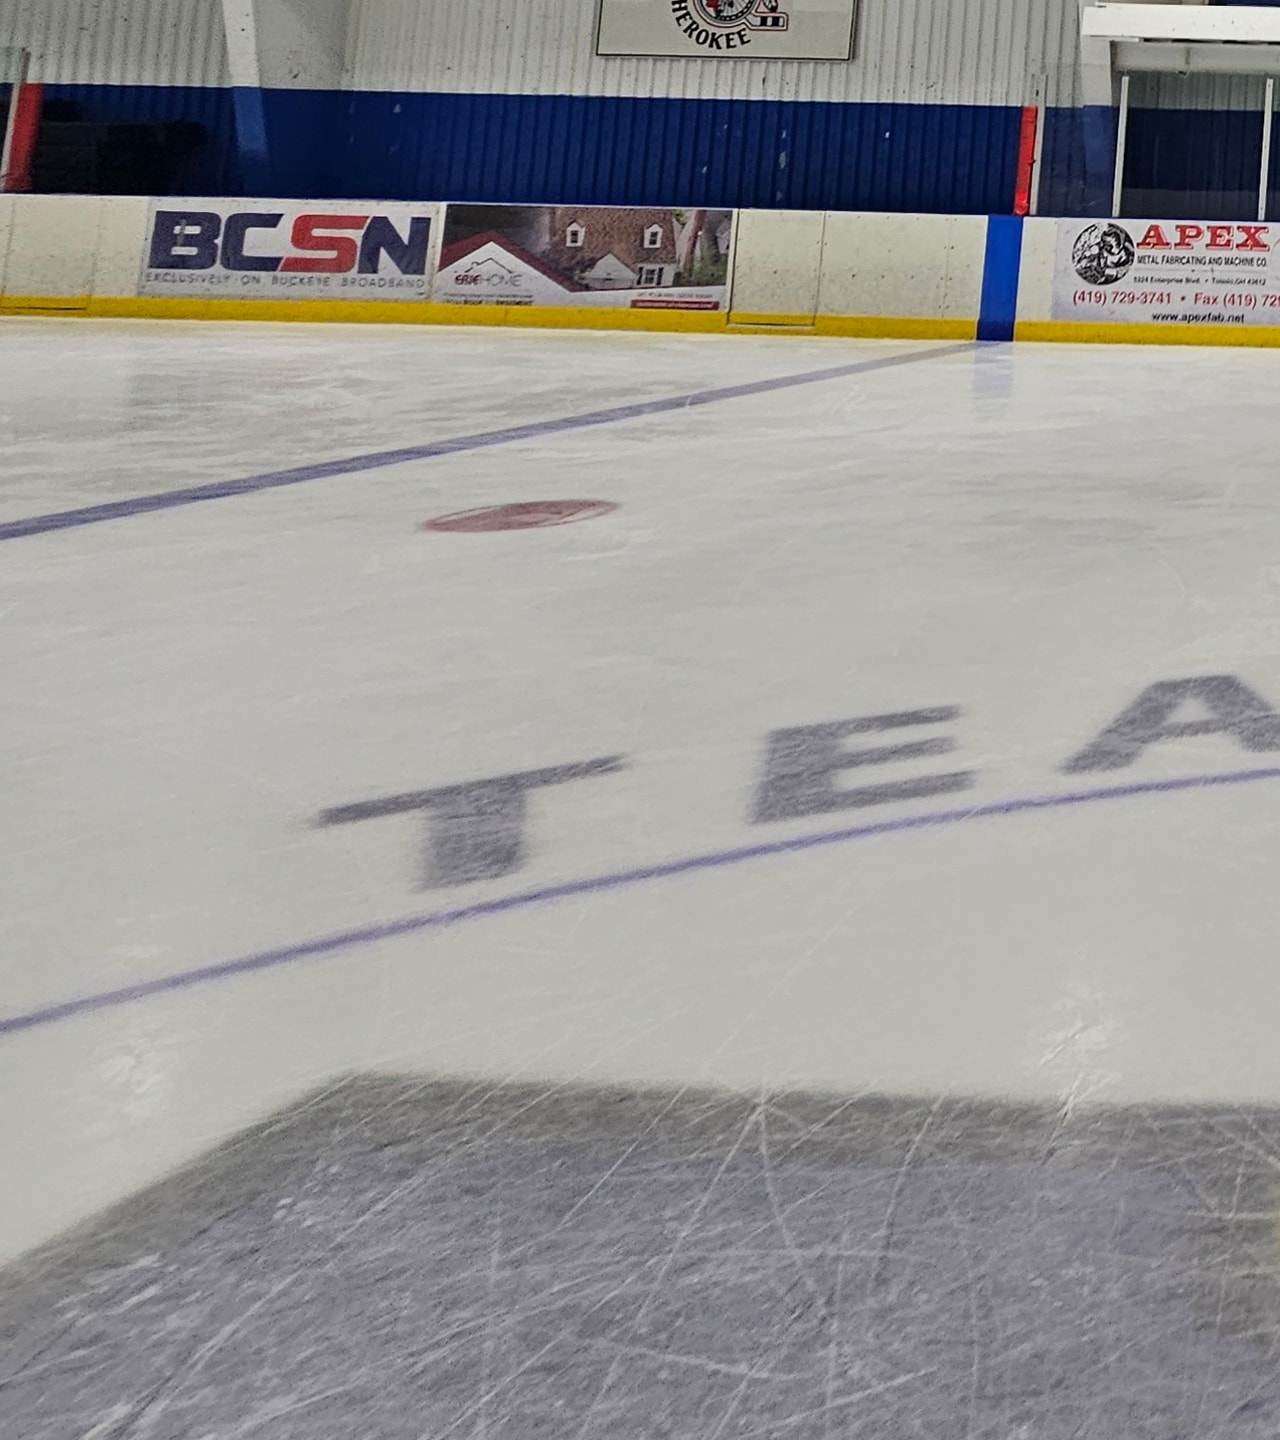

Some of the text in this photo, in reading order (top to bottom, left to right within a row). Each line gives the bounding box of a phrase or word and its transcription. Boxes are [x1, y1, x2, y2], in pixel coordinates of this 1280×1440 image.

[149, 210, 432, 275] BCSN
[1136, 224, 1270, 251] APEX
[1137, 255, 1160, 266] METAL
[1160, 255, 1207, 267] FABRICATING
[1208, 256, 1222, 266] AND
[1223, 257, 1255, 267] MACHINE
[145, 272, 426, 289] EXCLUSIVELY ON BUCKEYE BROADBAND
[1073, 290, 1107, 307] (419)
[1111, 291, 1172, 306] 729-3741
[1194, 292, 1218, 306] Fax
[1223, 293, 1257, 309] (419)
[1151, 311, 1246, 326] www.apexfab.net
